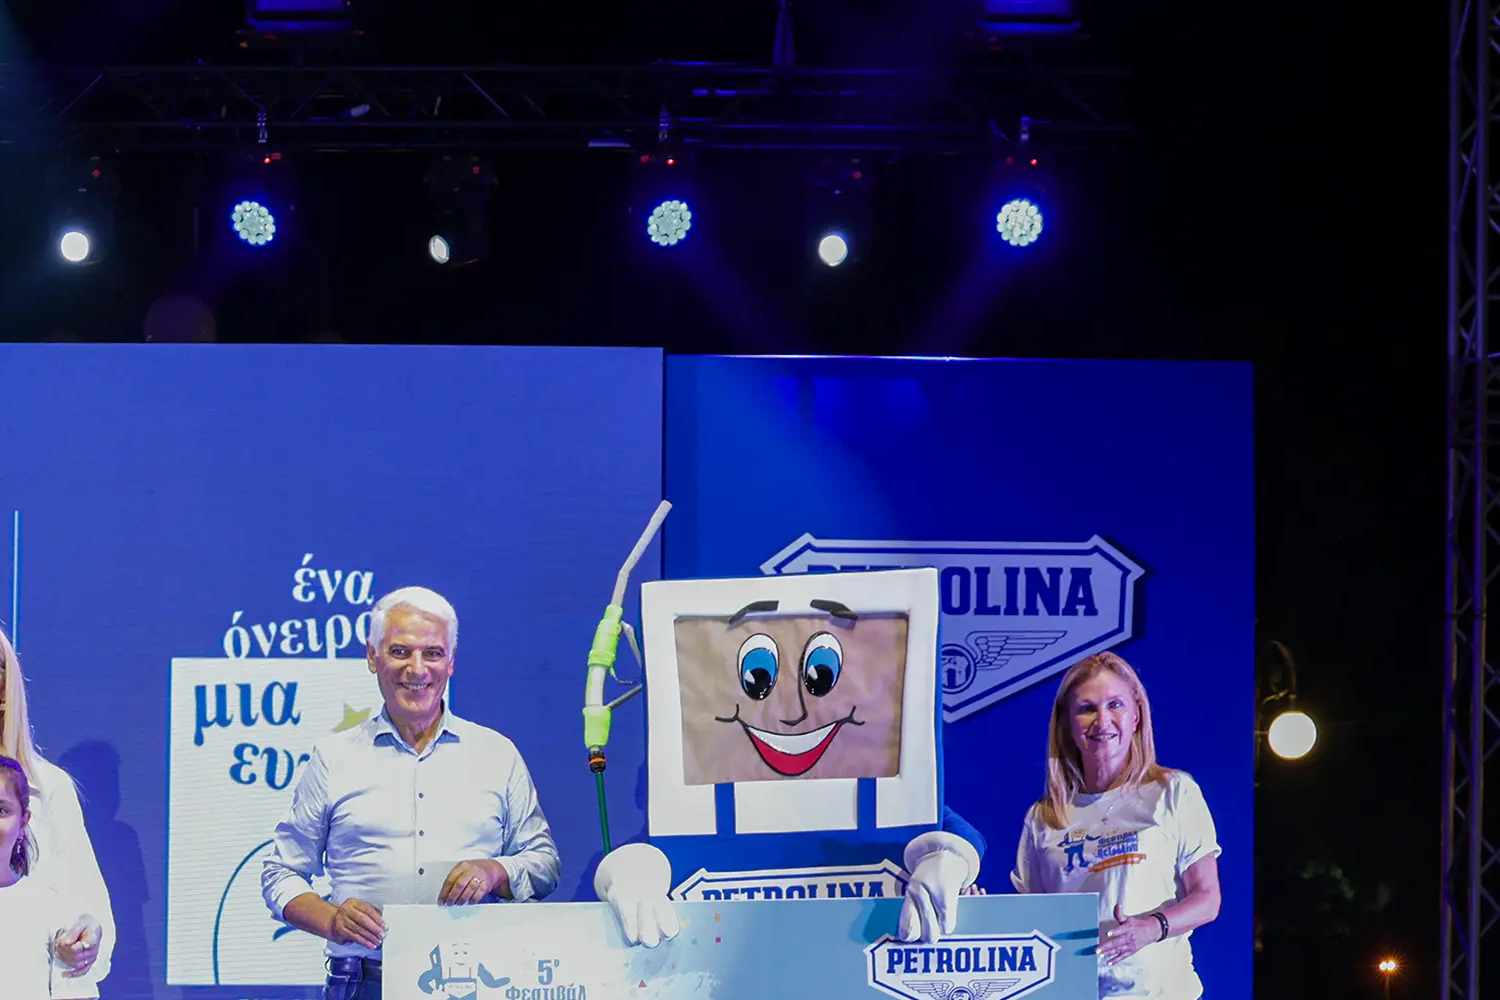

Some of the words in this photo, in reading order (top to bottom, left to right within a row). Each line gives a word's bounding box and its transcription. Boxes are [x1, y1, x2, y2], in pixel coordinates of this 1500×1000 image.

[292, 553, 374, 605] ένα
[194, 681, 300, 746] μια
[886, 946, 1036, 974] PETROLINA
